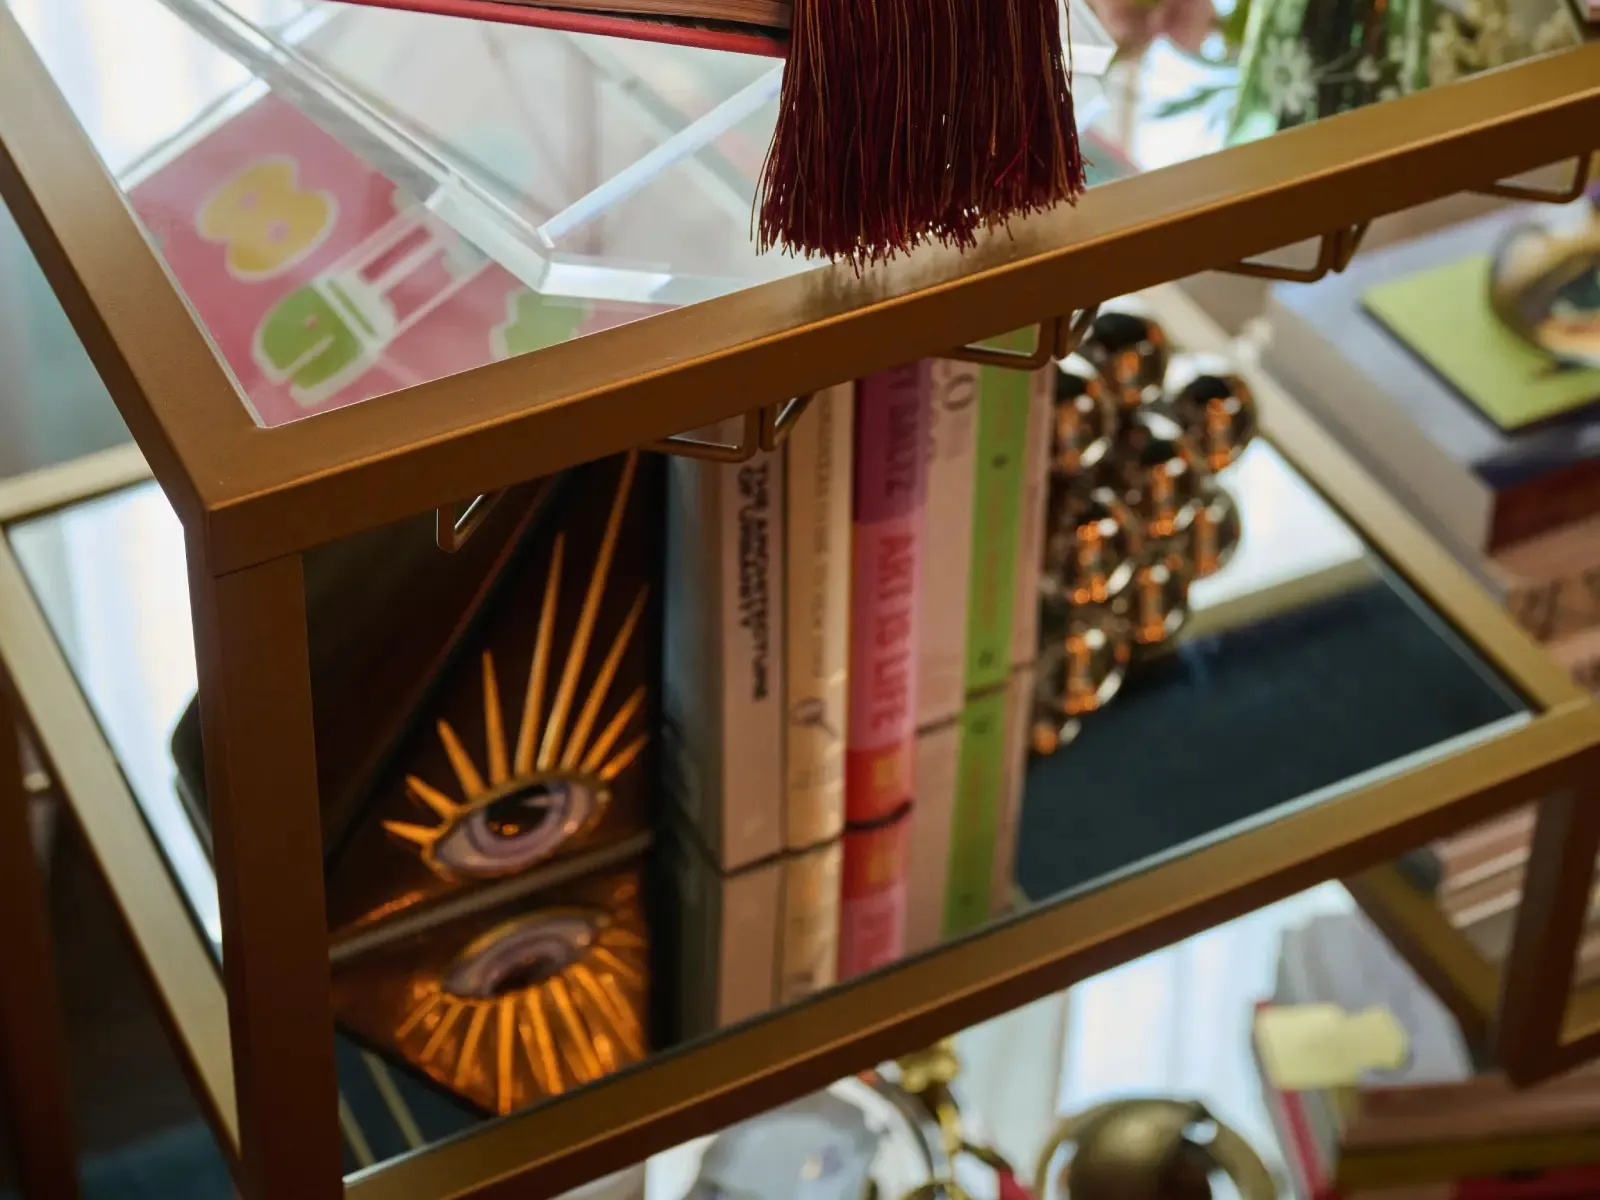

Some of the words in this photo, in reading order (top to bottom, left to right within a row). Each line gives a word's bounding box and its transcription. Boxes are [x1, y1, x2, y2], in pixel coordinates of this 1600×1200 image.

[753, 460, 771, 510] THE
[877, 532, 916, 601] ART
[874, 607, 912, 648] IS
[869, 650, 910, 731] LIFE
